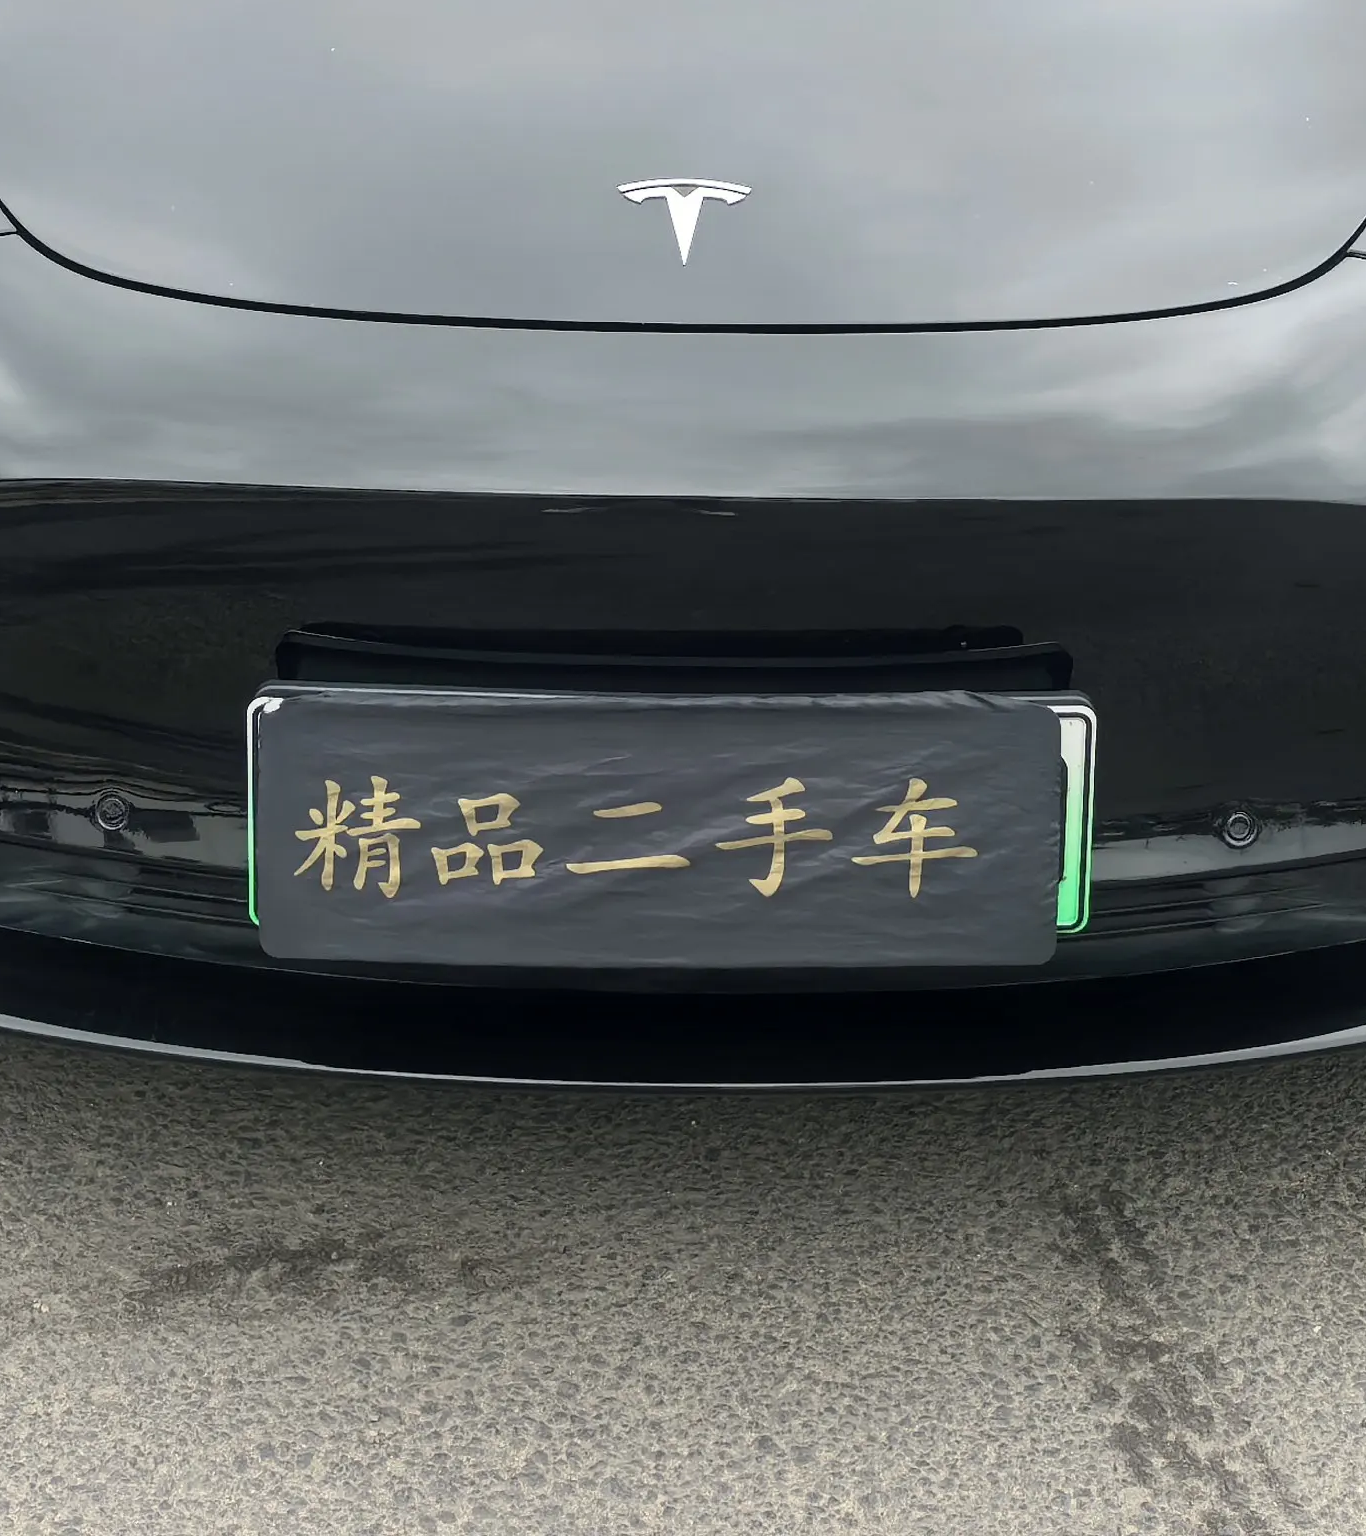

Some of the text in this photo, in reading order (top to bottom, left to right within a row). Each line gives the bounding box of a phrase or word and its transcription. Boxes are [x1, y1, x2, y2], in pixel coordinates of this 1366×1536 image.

[293, 774, 979, 898] 精品二手车
